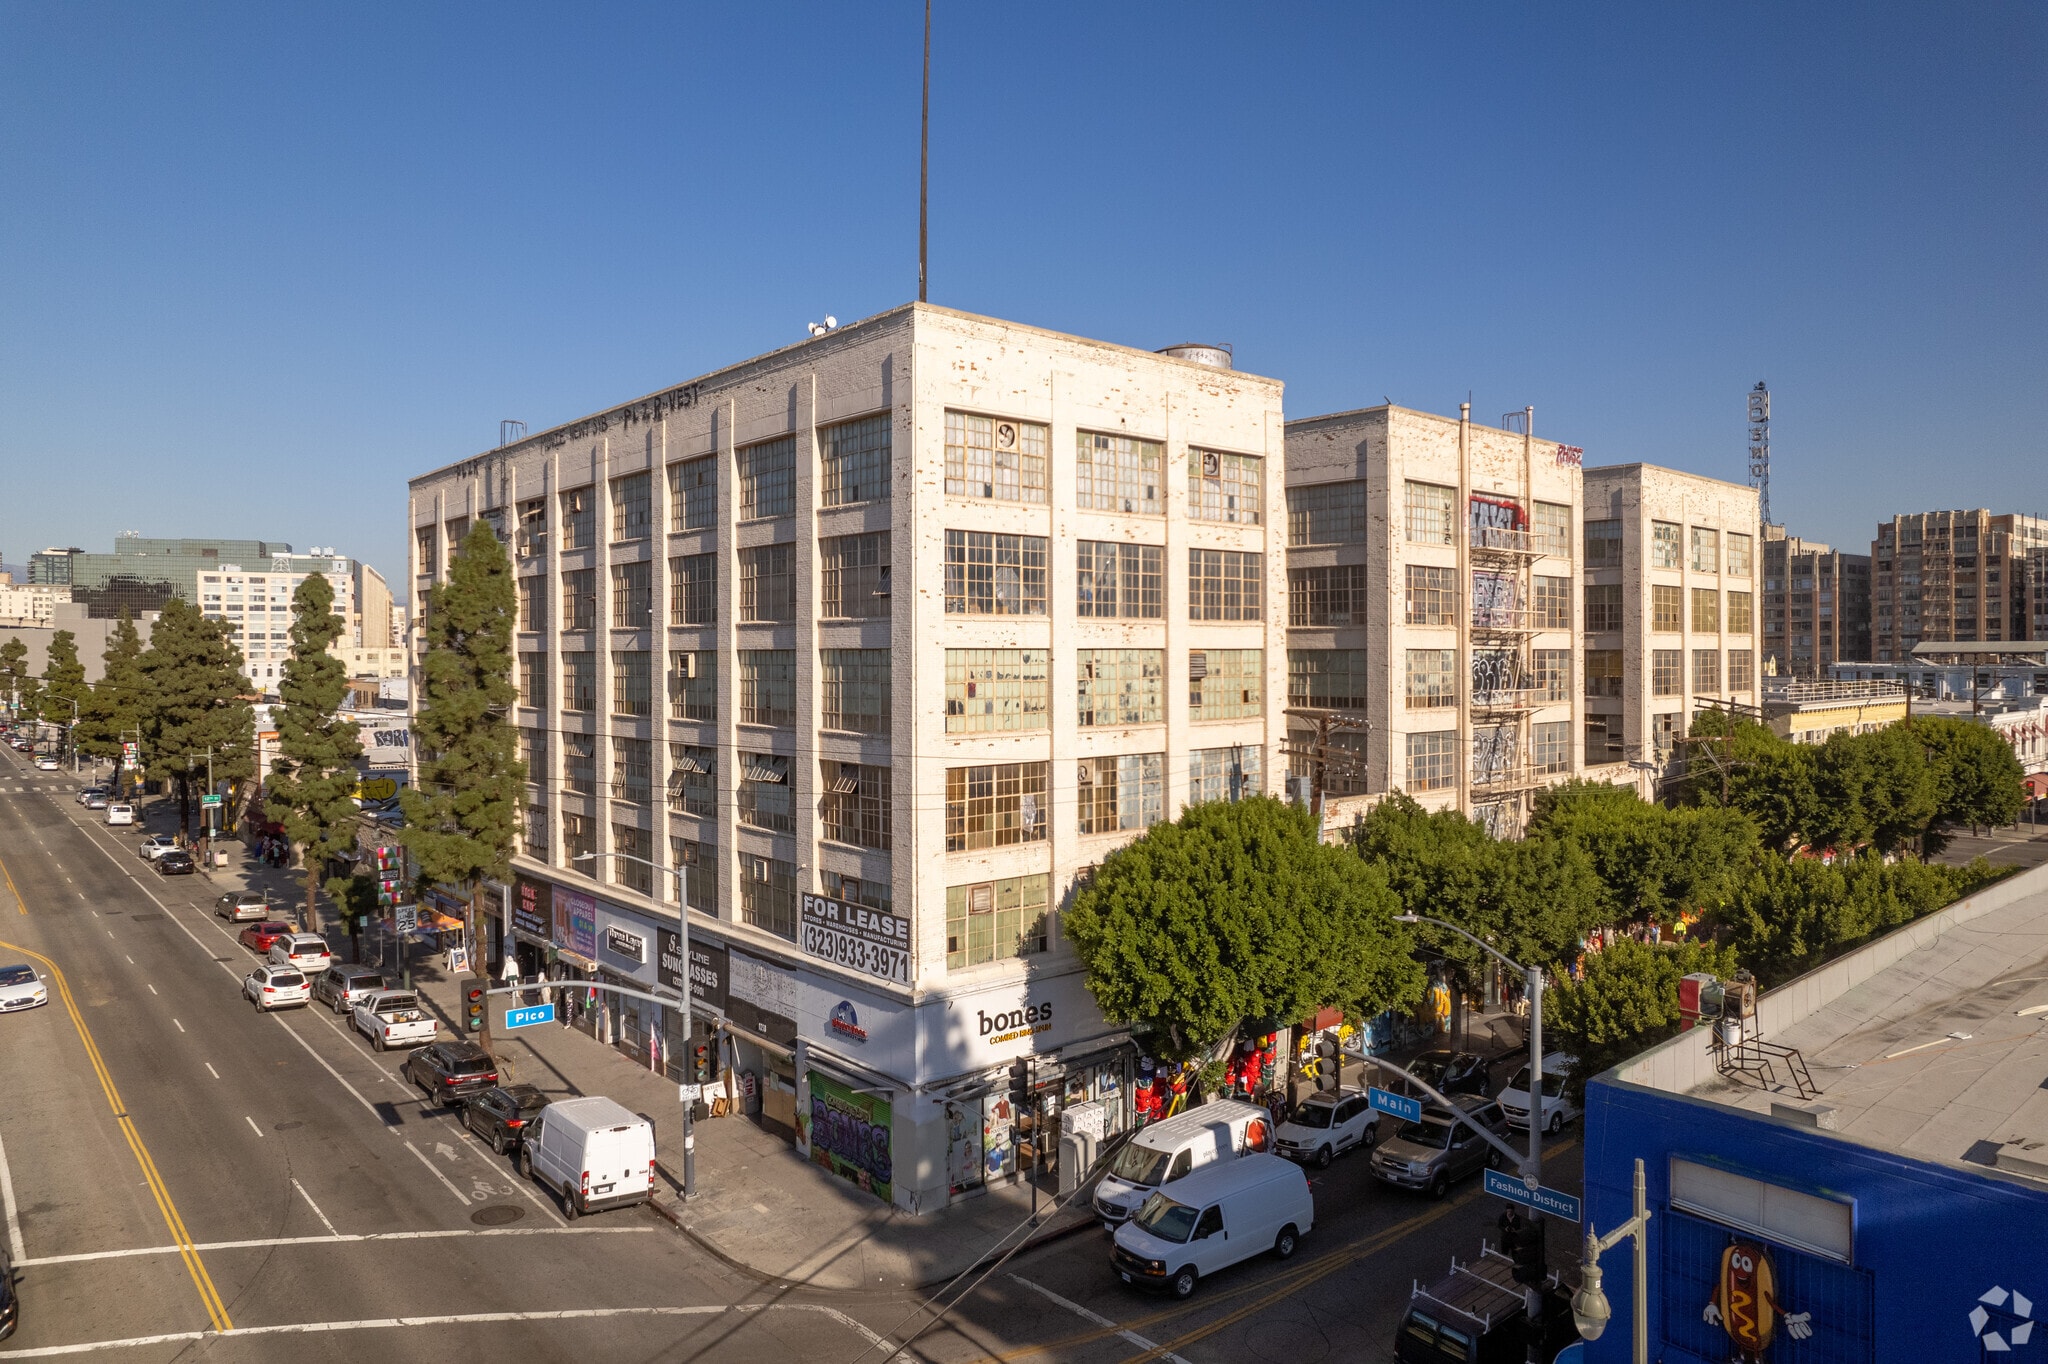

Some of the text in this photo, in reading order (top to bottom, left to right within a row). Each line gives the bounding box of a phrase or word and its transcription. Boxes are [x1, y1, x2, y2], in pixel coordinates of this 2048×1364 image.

[399, 919, 415, 931] 25
[573, 907, 594, 921] APPAREL
[804, 896, 907, 939] FOR LEASE
[804, 914, 907, 948] STORES WAREHOUSES MANUFACTURING
[805, 925, 907, 982] (323)933-3971
[515, 1011, 545, 1023] Pico
[977, 1002, 1052, 1036] bones
[1377, 1093, 1411, 1114] Main
[1490, 1178, 1574, 1213] Fashion District
